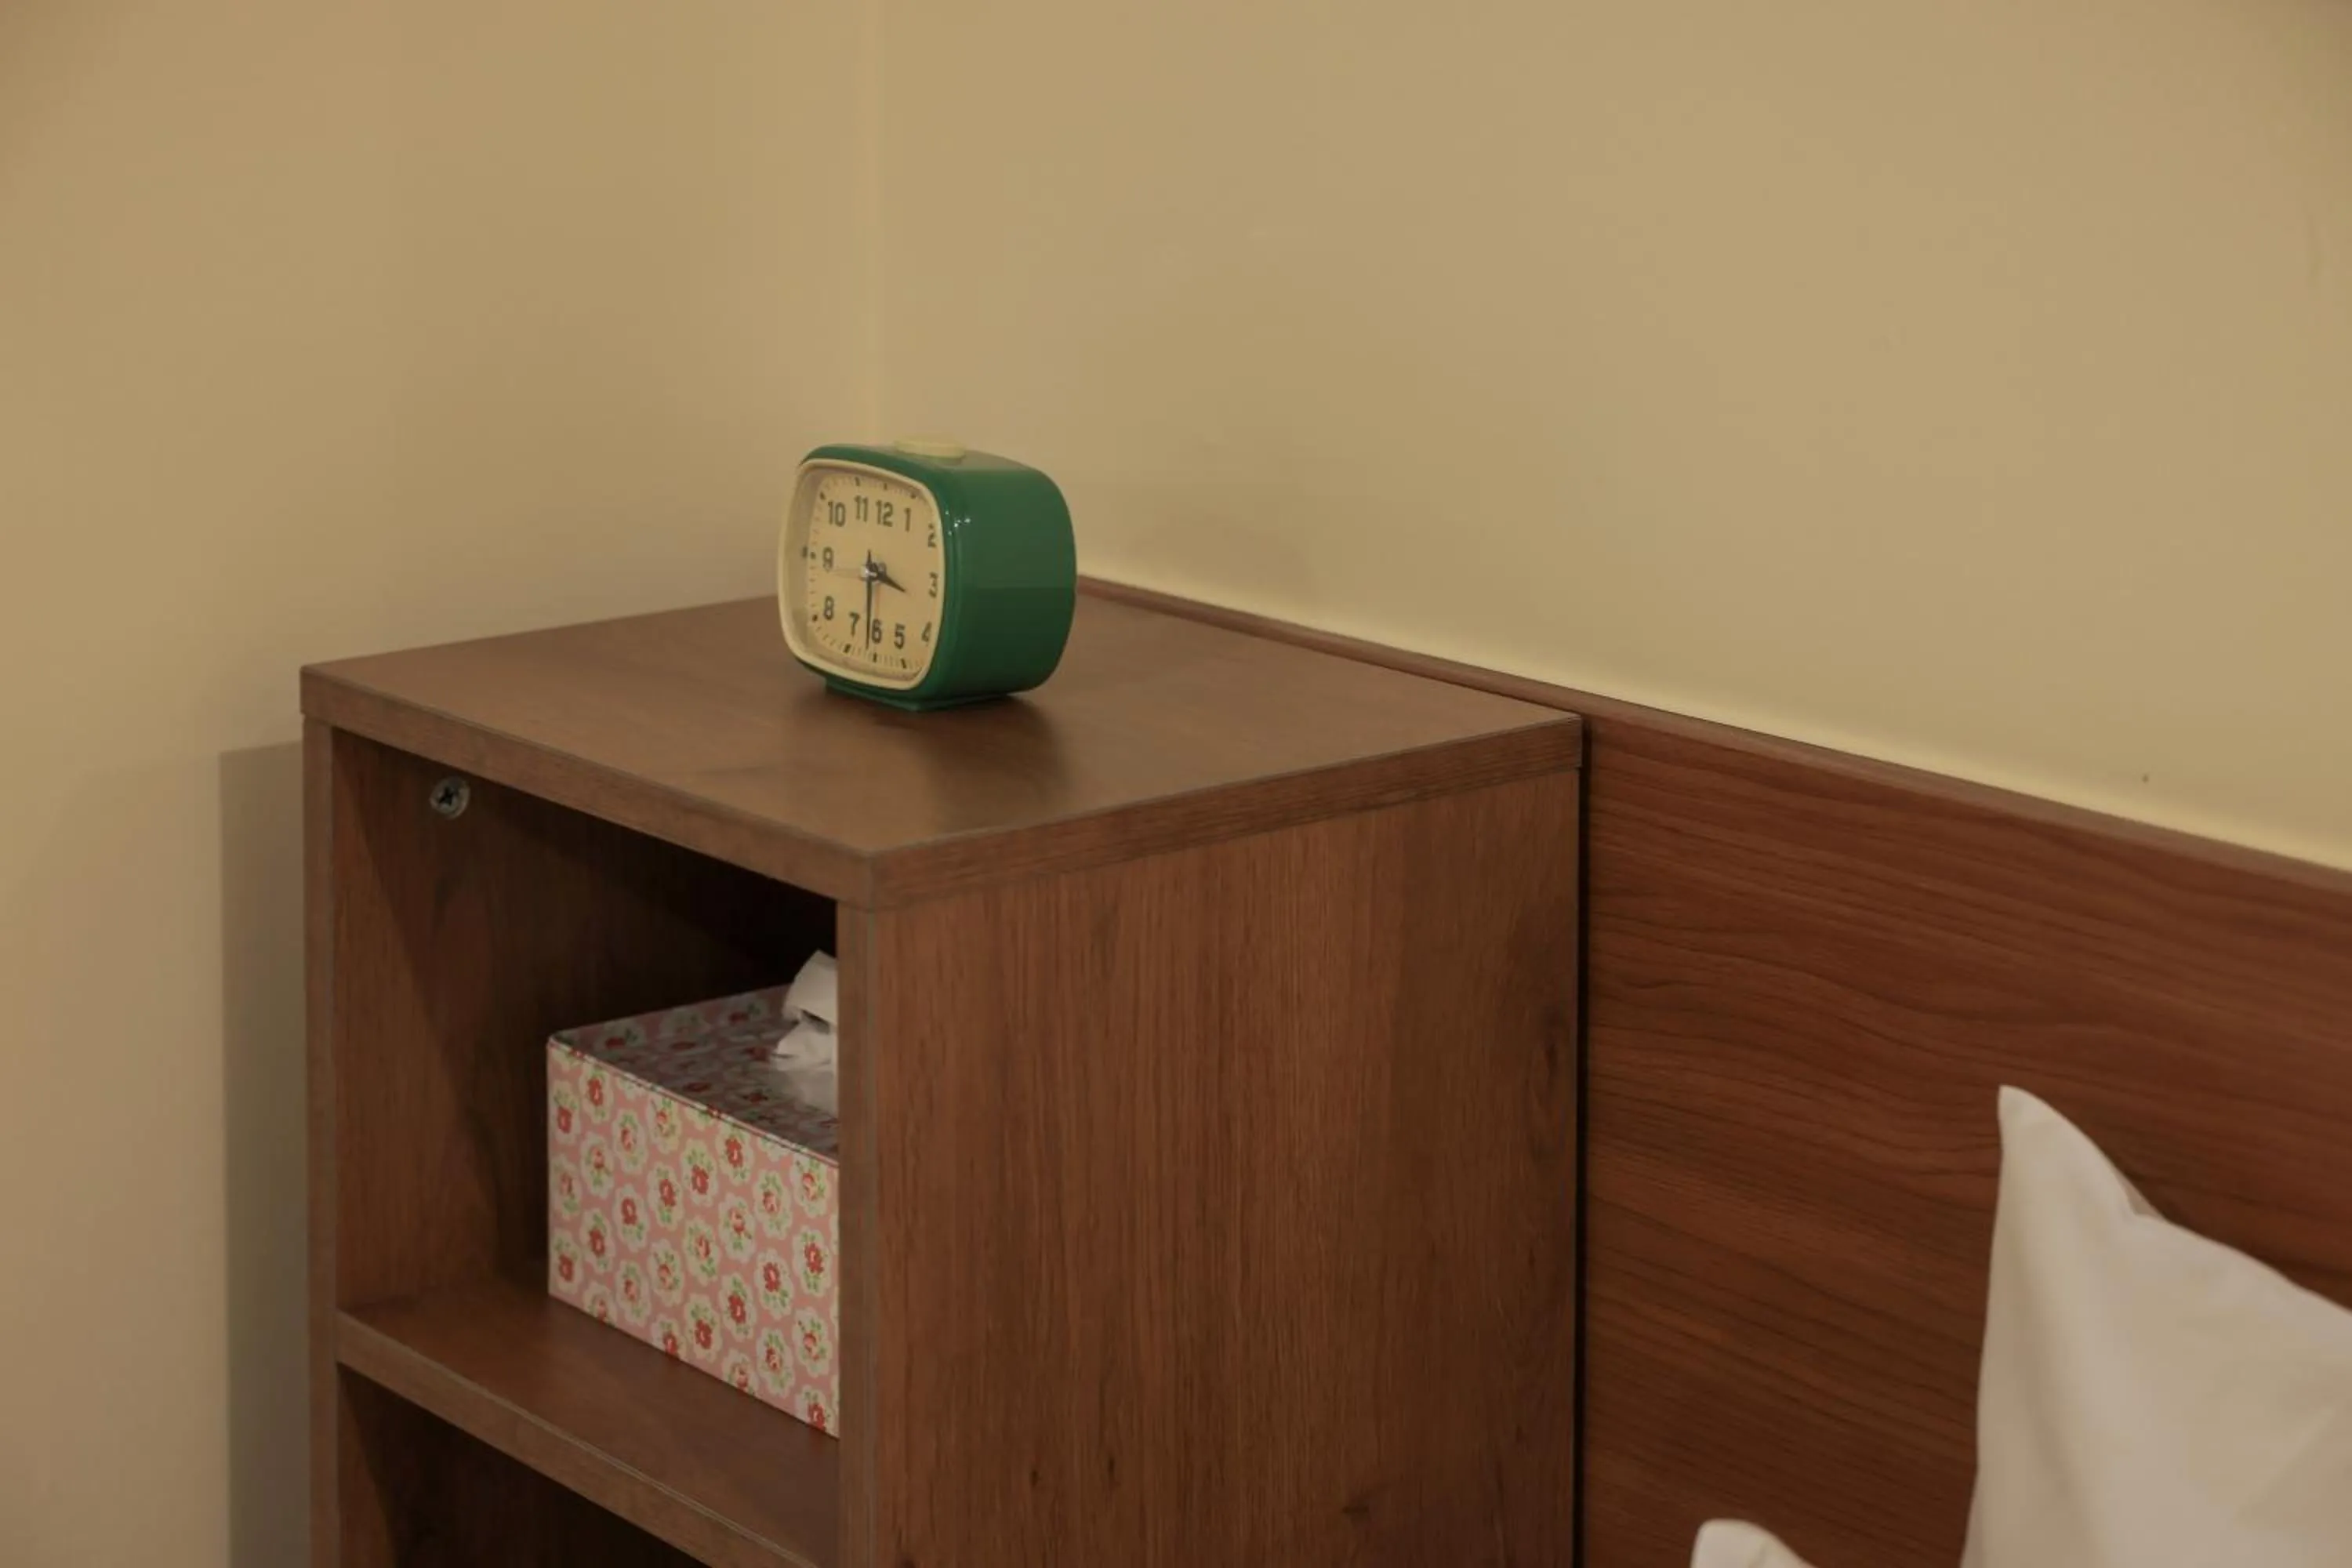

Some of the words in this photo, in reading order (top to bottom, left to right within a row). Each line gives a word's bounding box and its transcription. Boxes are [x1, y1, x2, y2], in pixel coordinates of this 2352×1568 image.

[828, 500, 846, 527] 10
[855, 495, 869, 522] 11
[876, 499, 894, 527] 12
[903, 508, 912, 532] 1
[927, 523, 936, 548] 2
[822, 547, 833, 571] 9
[929, 572, 938, 597] 3
[823, 597, 834, 620] 8
[849, 612, 860, 637] 7
[872, 619, 882, 643] 6
[894, 623, 906, 649] 5
[922, 622, 932, 647] 4
